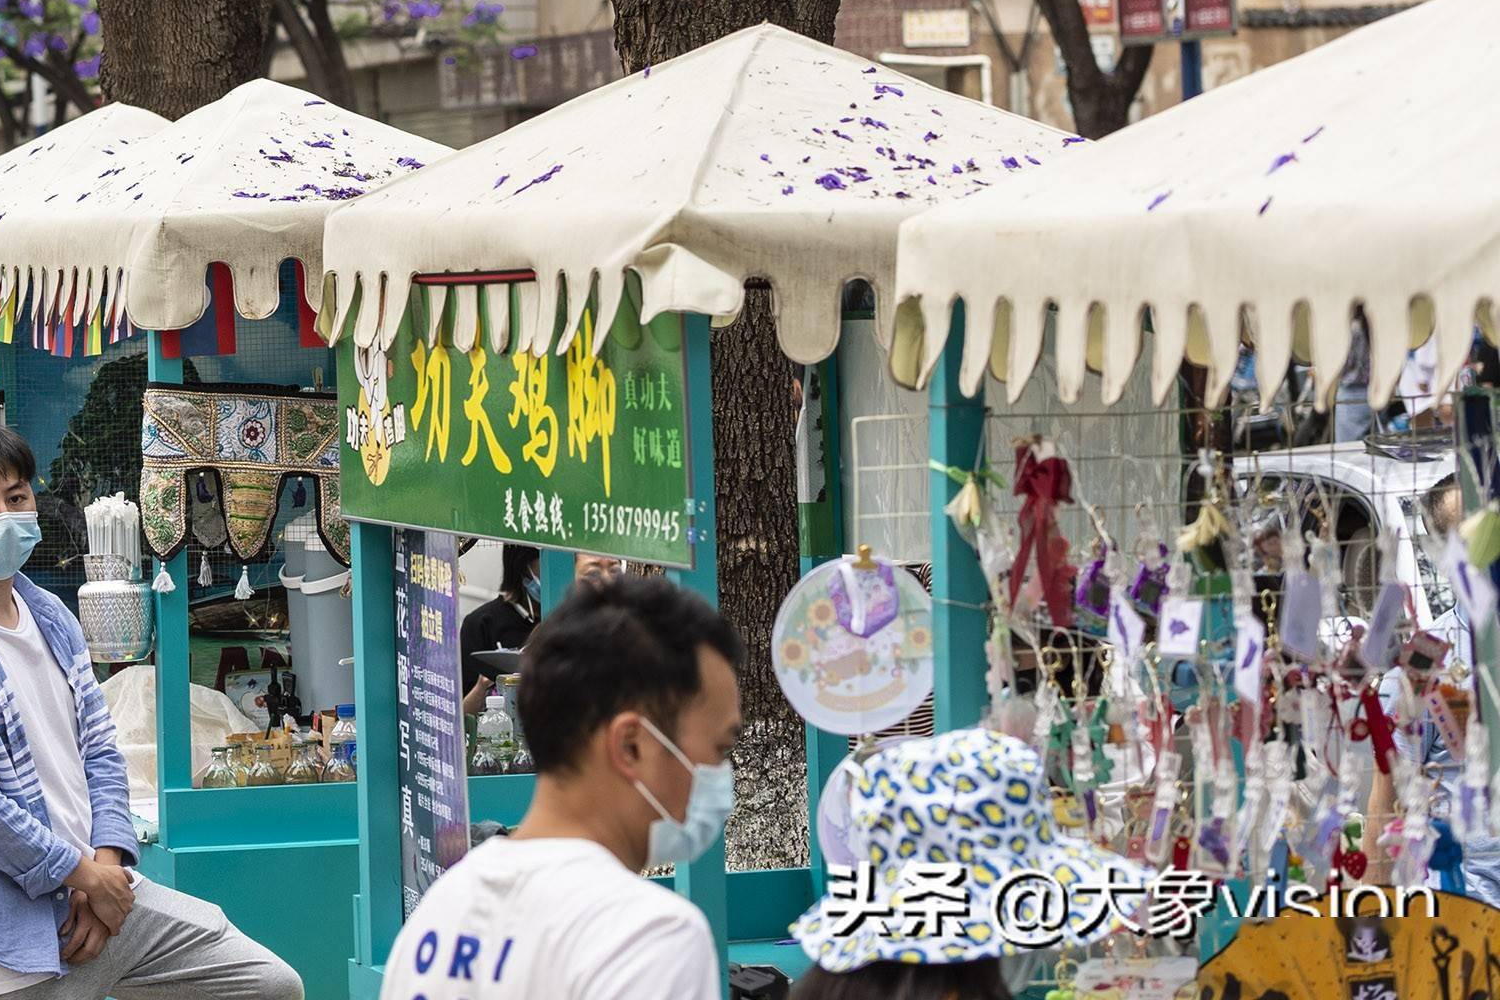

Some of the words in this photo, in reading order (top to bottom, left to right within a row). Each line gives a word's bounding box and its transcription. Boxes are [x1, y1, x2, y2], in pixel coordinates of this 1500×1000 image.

[410, 309, 616, 498] 功夫鸡脚
[624, 369, 672, 411] 真功夫
[632, 426, 682, 469] 好味道
[582, 502, 681, 543] 13518799945
[420, 604, 444, 644] 拍立得
[415, 929, 514, 983] ORI
